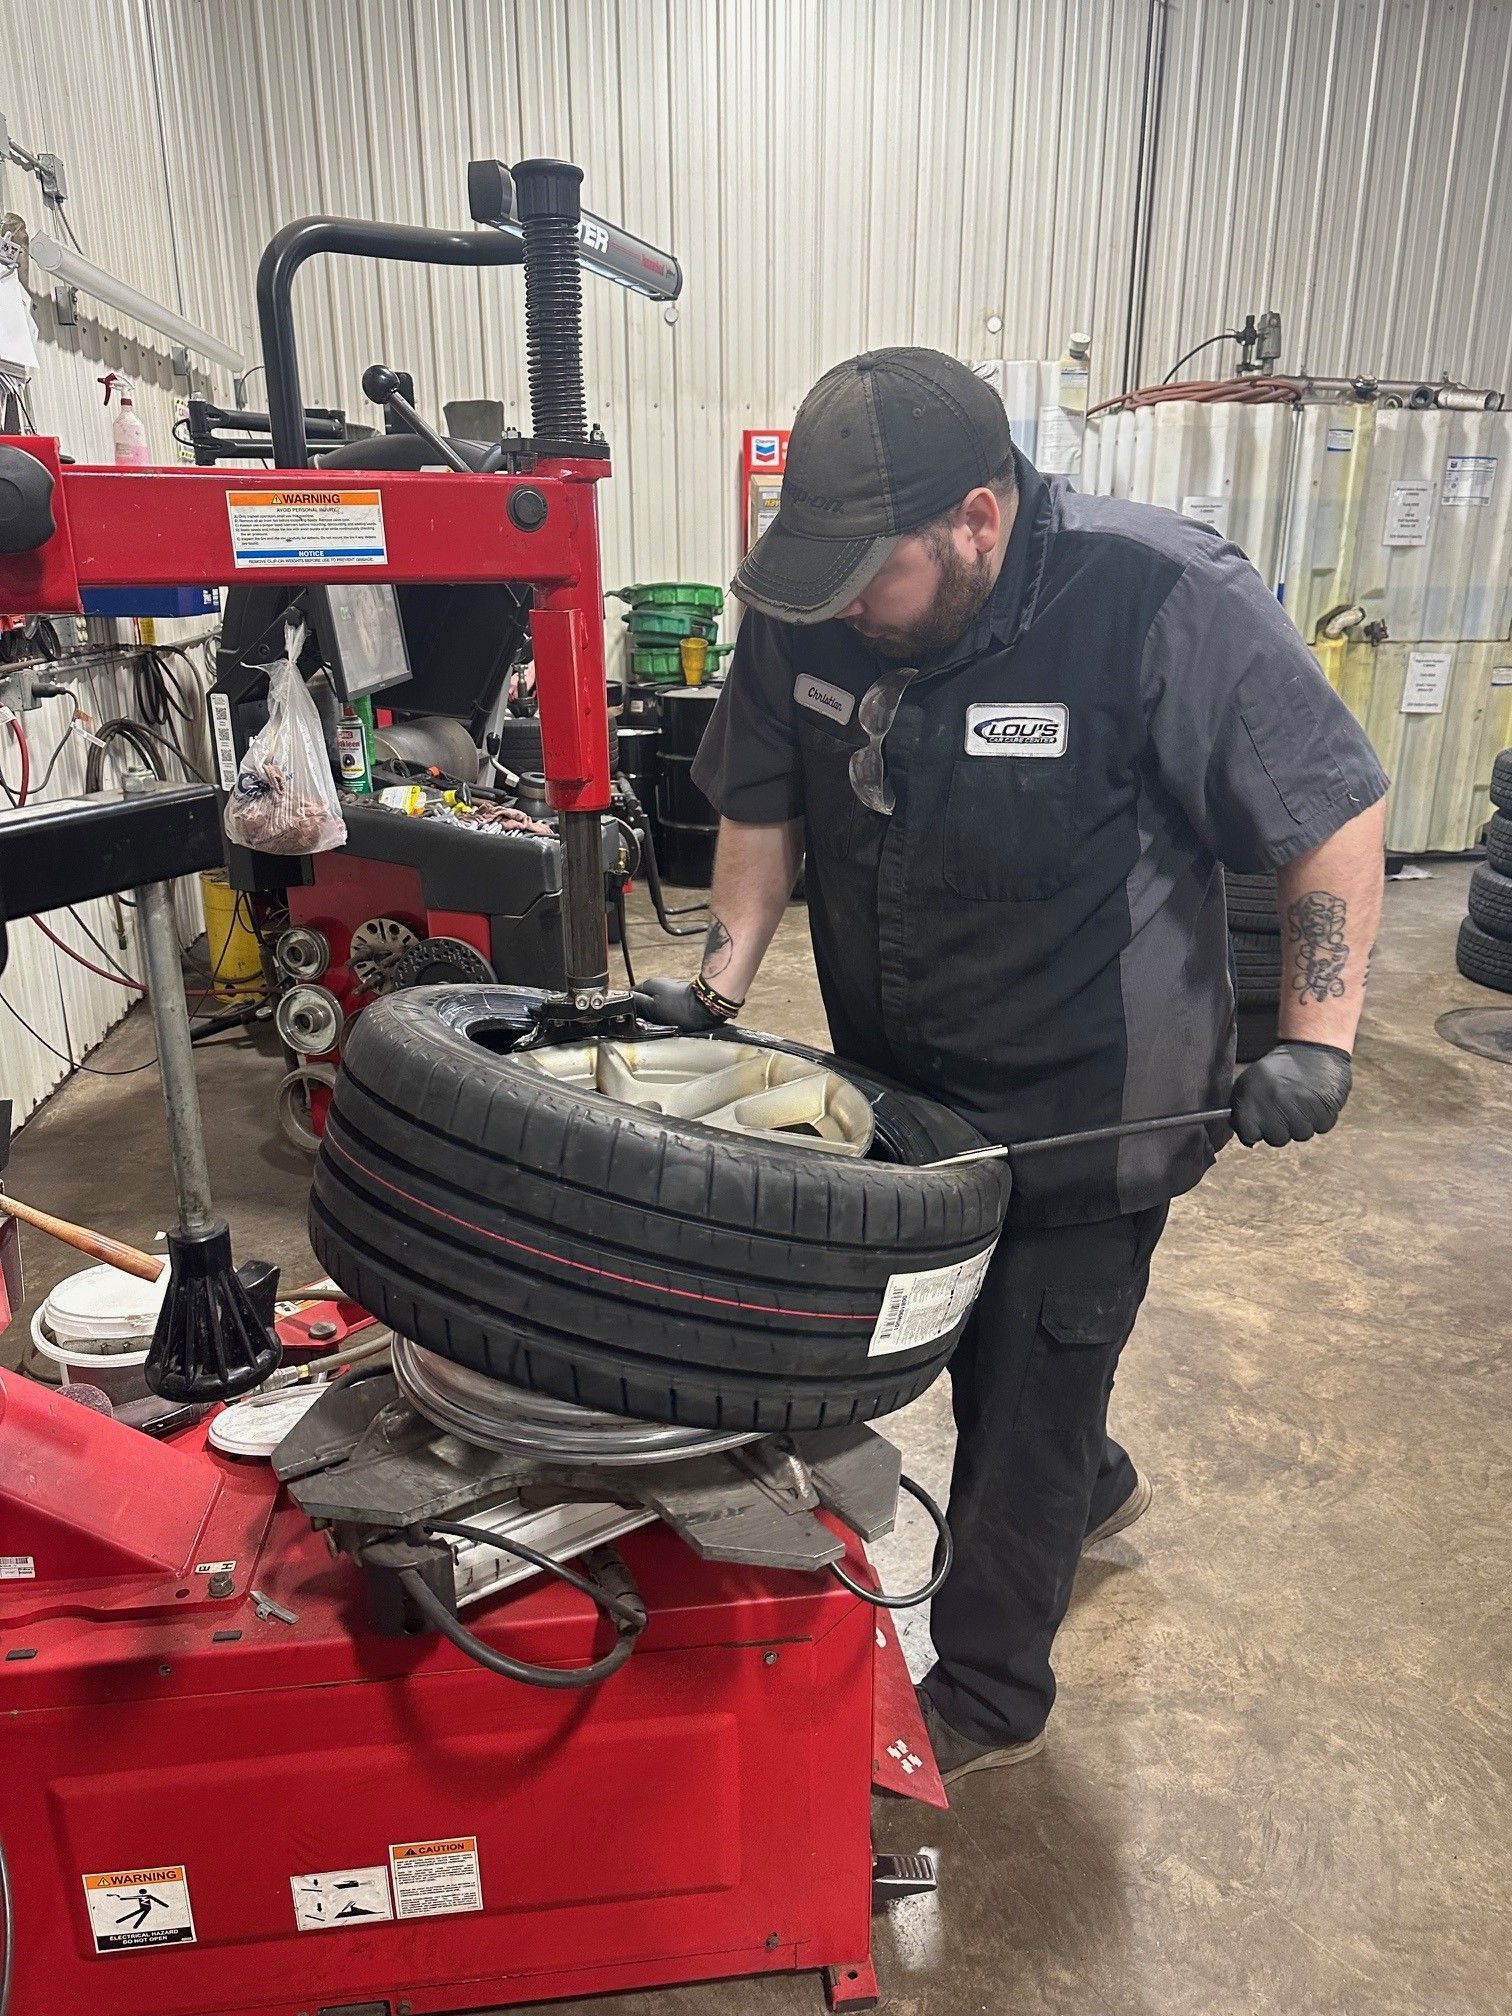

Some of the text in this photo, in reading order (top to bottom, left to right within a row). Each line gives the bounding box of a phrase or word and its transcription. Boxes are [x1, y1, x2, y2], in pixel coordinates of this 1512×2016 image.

[282, 494, 340, 505] WARNING
[808, 686, 842, 711] Christian
[989, 724, 1058, 736] LOU'S
[419, 1843, 464, 1854] CAUTION
[110, 1871, 176, 1884] WARNING
[109, 1933, 149, 1941] ELECTRICAL
